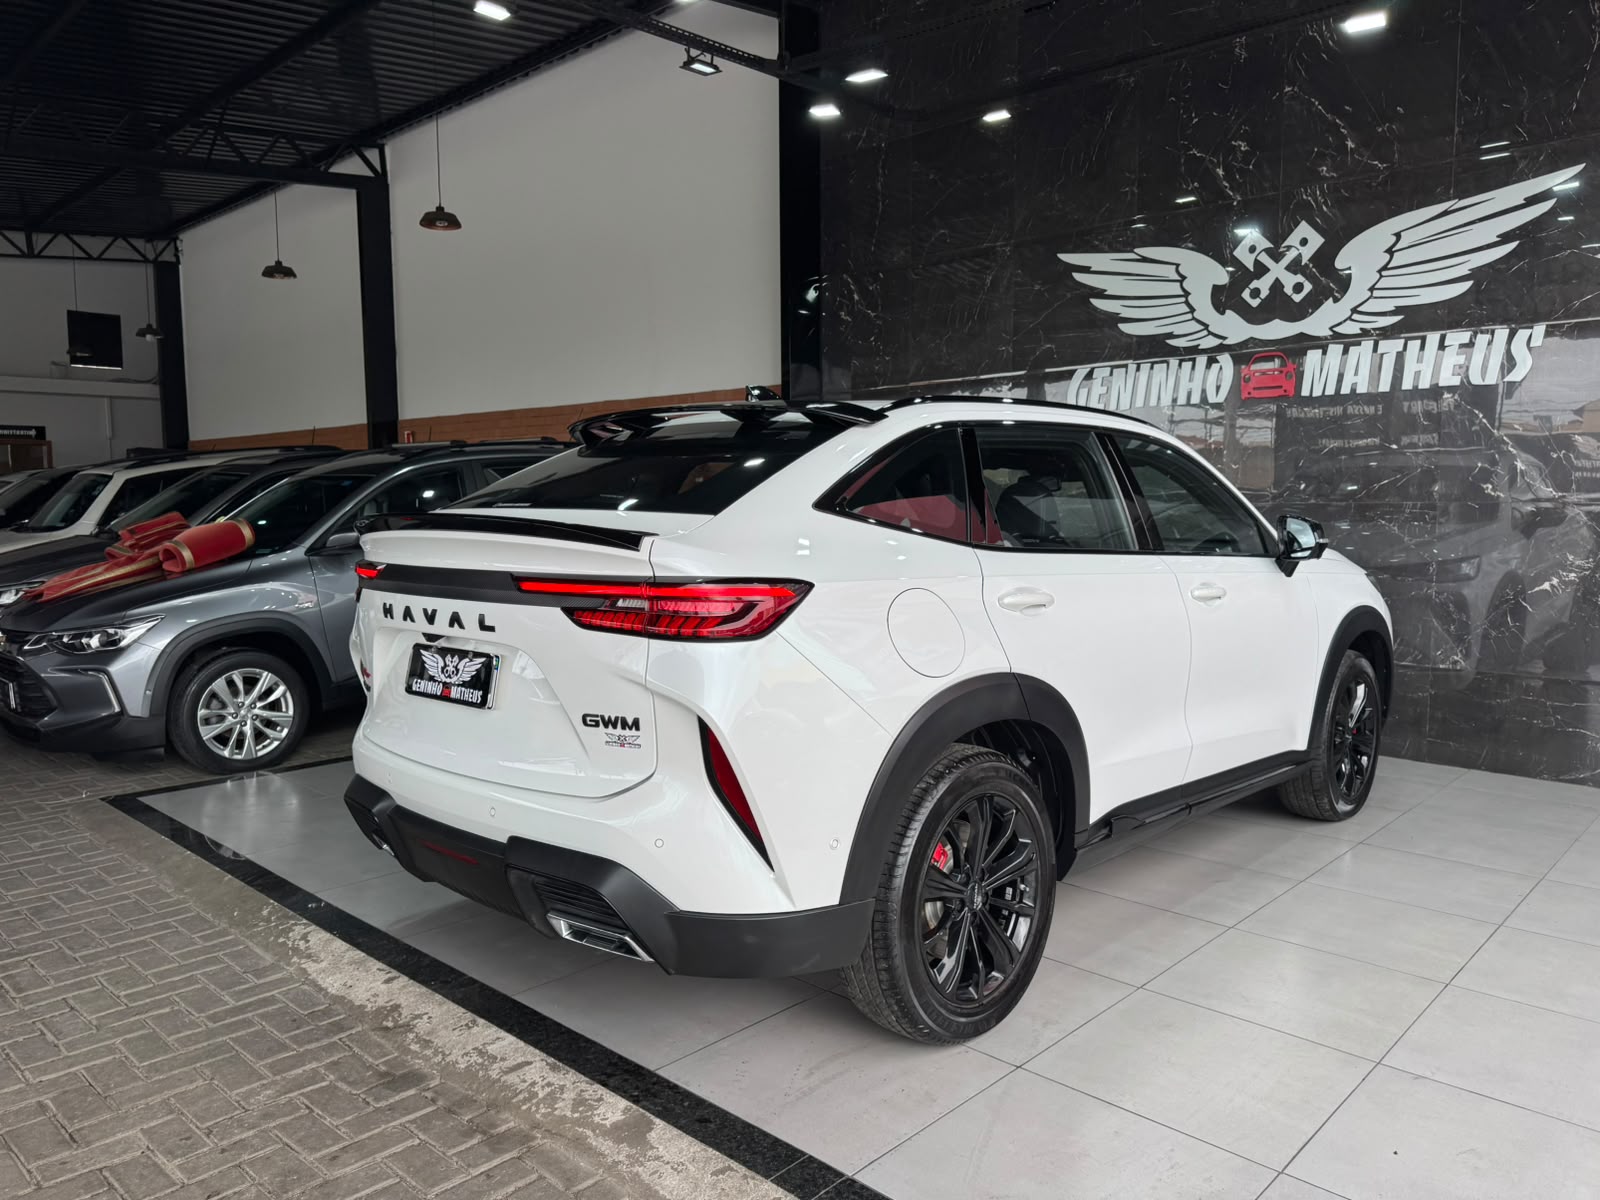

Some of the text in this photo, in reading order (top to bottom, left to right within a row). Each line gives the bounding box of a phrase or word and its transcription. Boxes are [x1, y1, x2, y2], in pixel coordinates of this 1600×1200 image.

[1067, 325, 1547, 411] GENINHO MATHEUS
[383, 602, 496, 633] HAVAL
[412, 678, 483, 704] GENINHO MATHEUS
[582, 713, 641, 731] GWM
